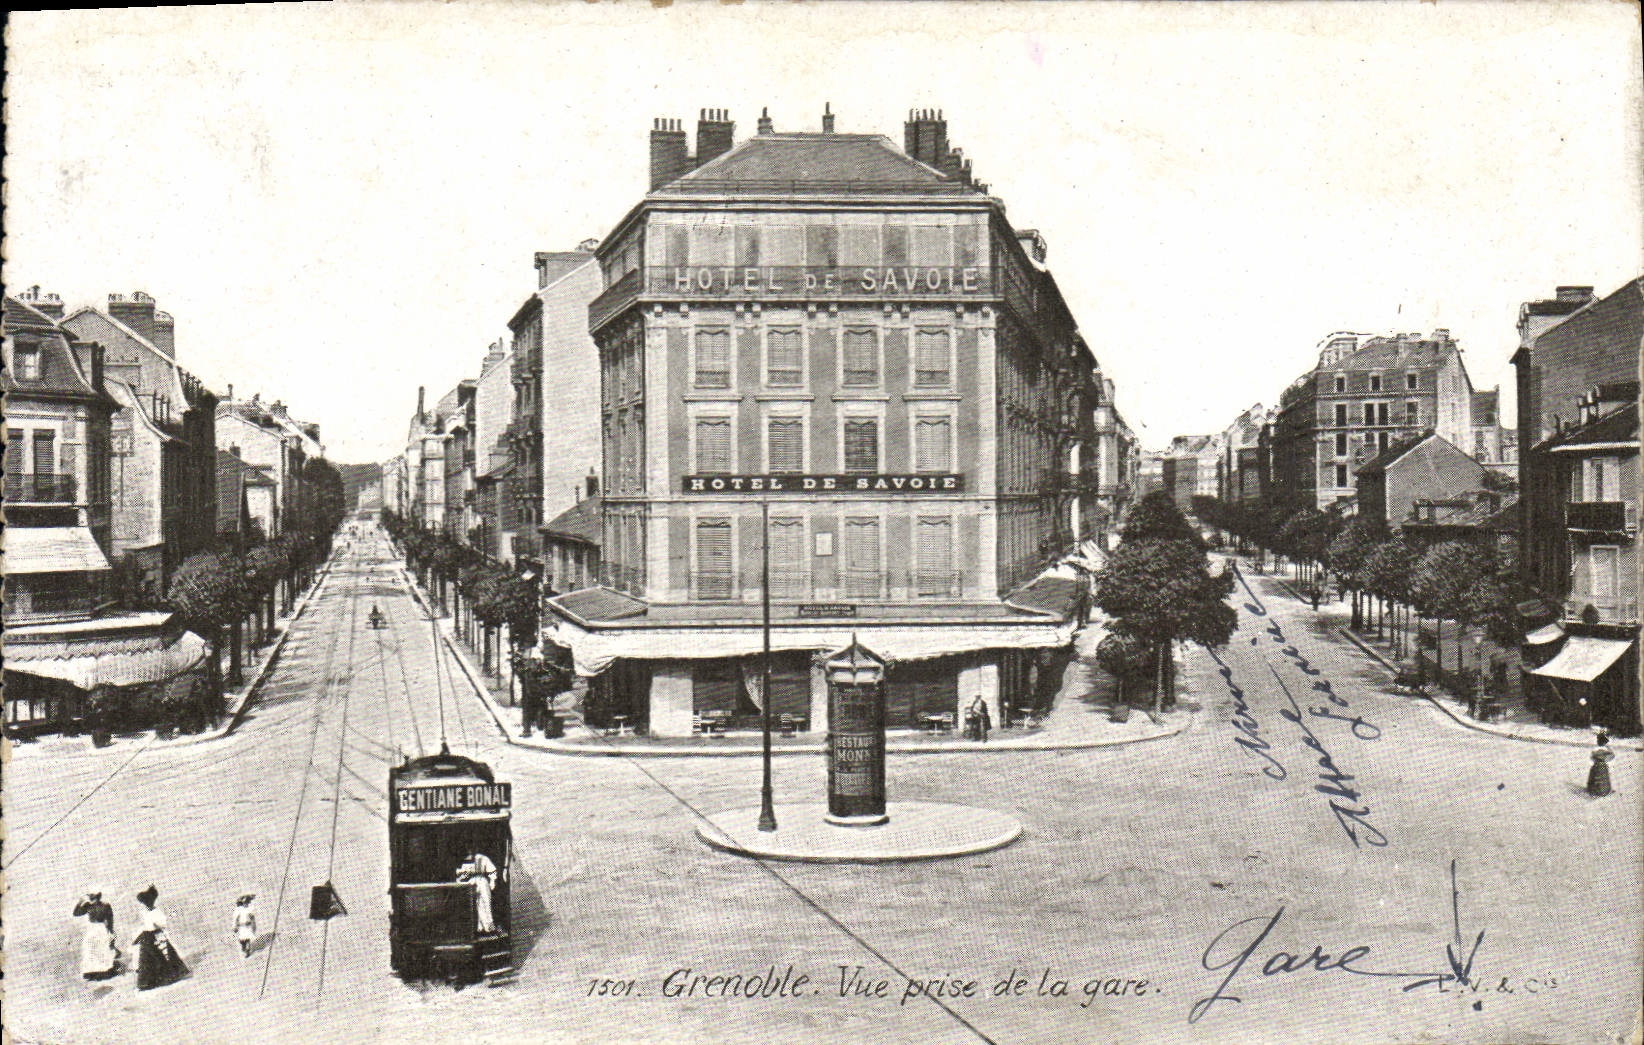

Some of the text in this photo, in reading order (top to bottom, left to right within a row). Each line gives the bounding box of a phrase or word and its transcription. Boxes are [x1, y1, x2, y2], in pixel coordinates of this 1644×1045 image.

[674, 267, 979, 291] HOTEL DE SAVOIE
[690, 477, 956, 490] HOTEL DE SAVOIE
[399, 783, 509, 811] GENTIANE BONAL
